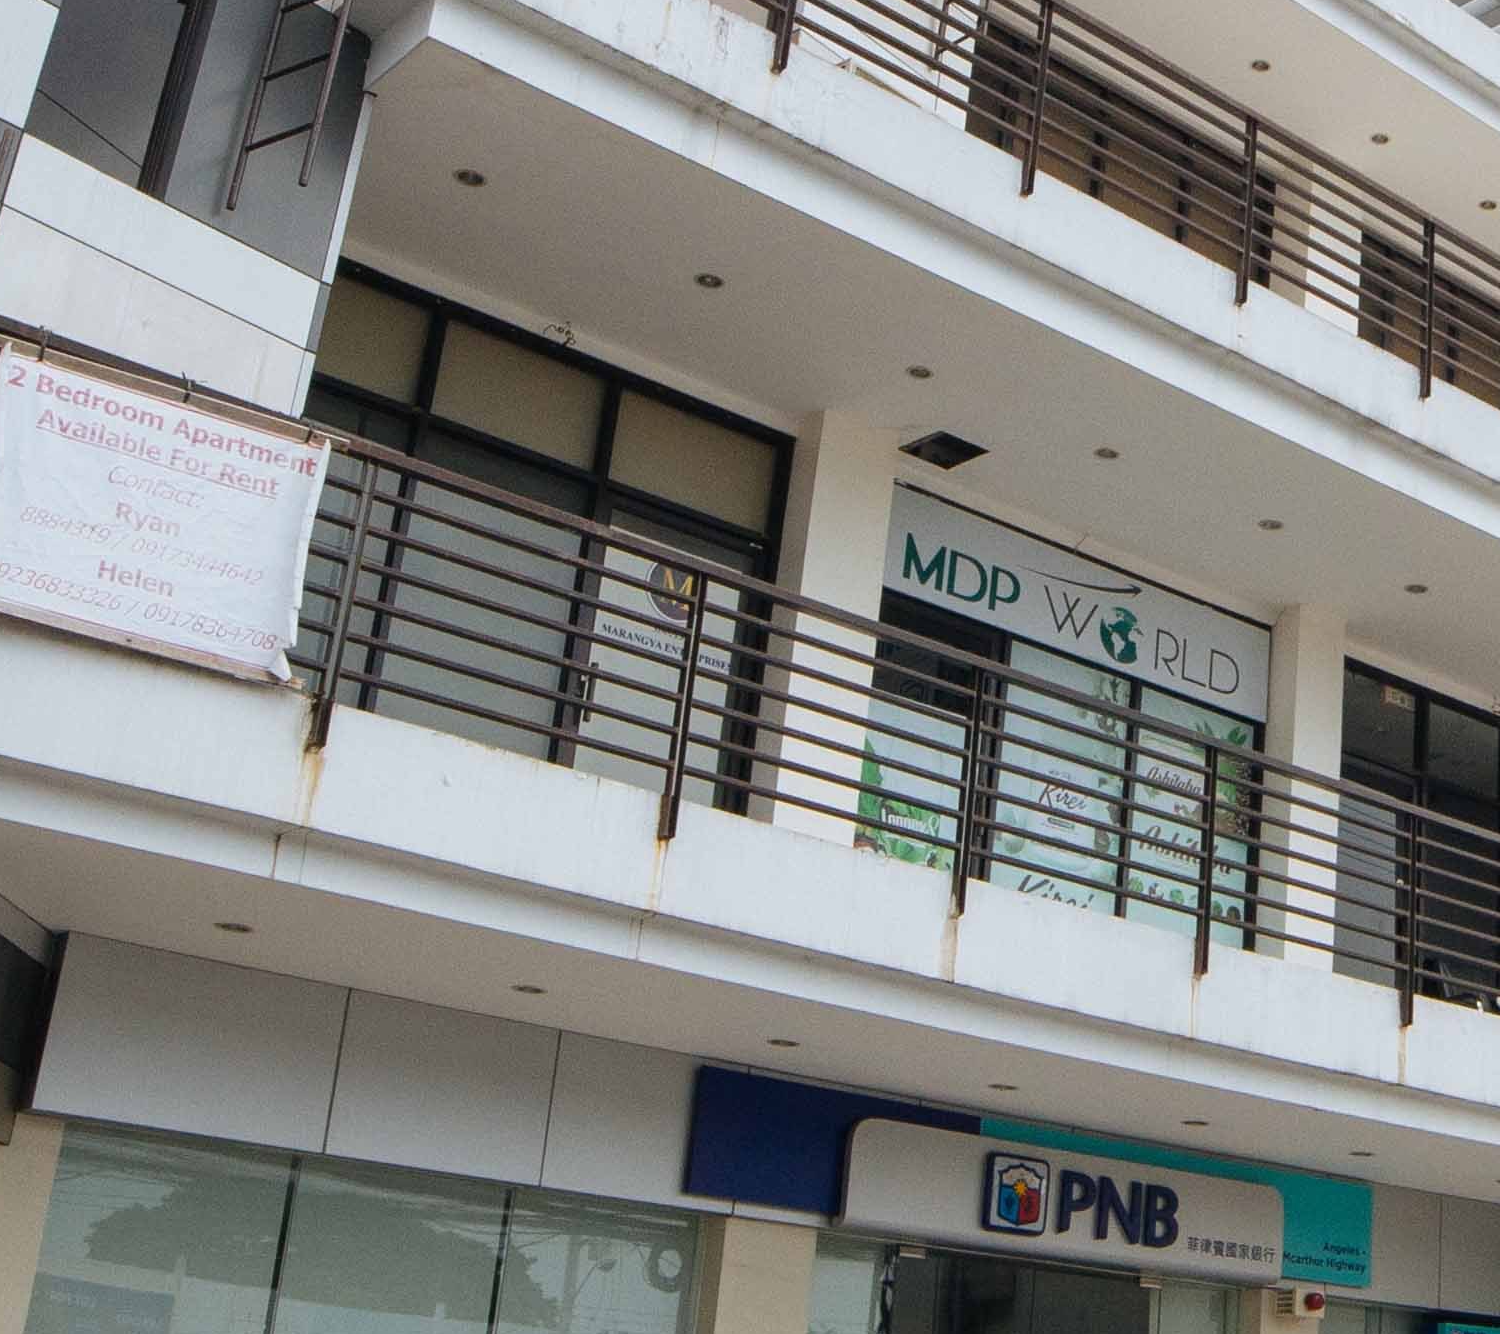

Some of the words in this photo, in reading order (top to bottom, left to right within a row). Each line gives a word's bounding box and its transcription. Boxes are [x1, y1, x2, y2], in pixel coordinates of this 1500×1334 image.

[8, 366, 26, 388] 2
[36, 373, 165, 431] Bedroom
[172, 417, 318, 478] Apartment
[37, 409, 162, 461] Available
[169, 448, 210, 476] For
[218, 463, 281, 497] Rent
[115, 501, 181, 538] Ryan
[97, 559, 175, 598] Helen
[902, 532, 1021, 611] MDP
[601, 623, 663, 652] MARANGYA
[1055, 1169, 1180, 1249] PNB
[1326, 1257, 1367, 1275] Highway
